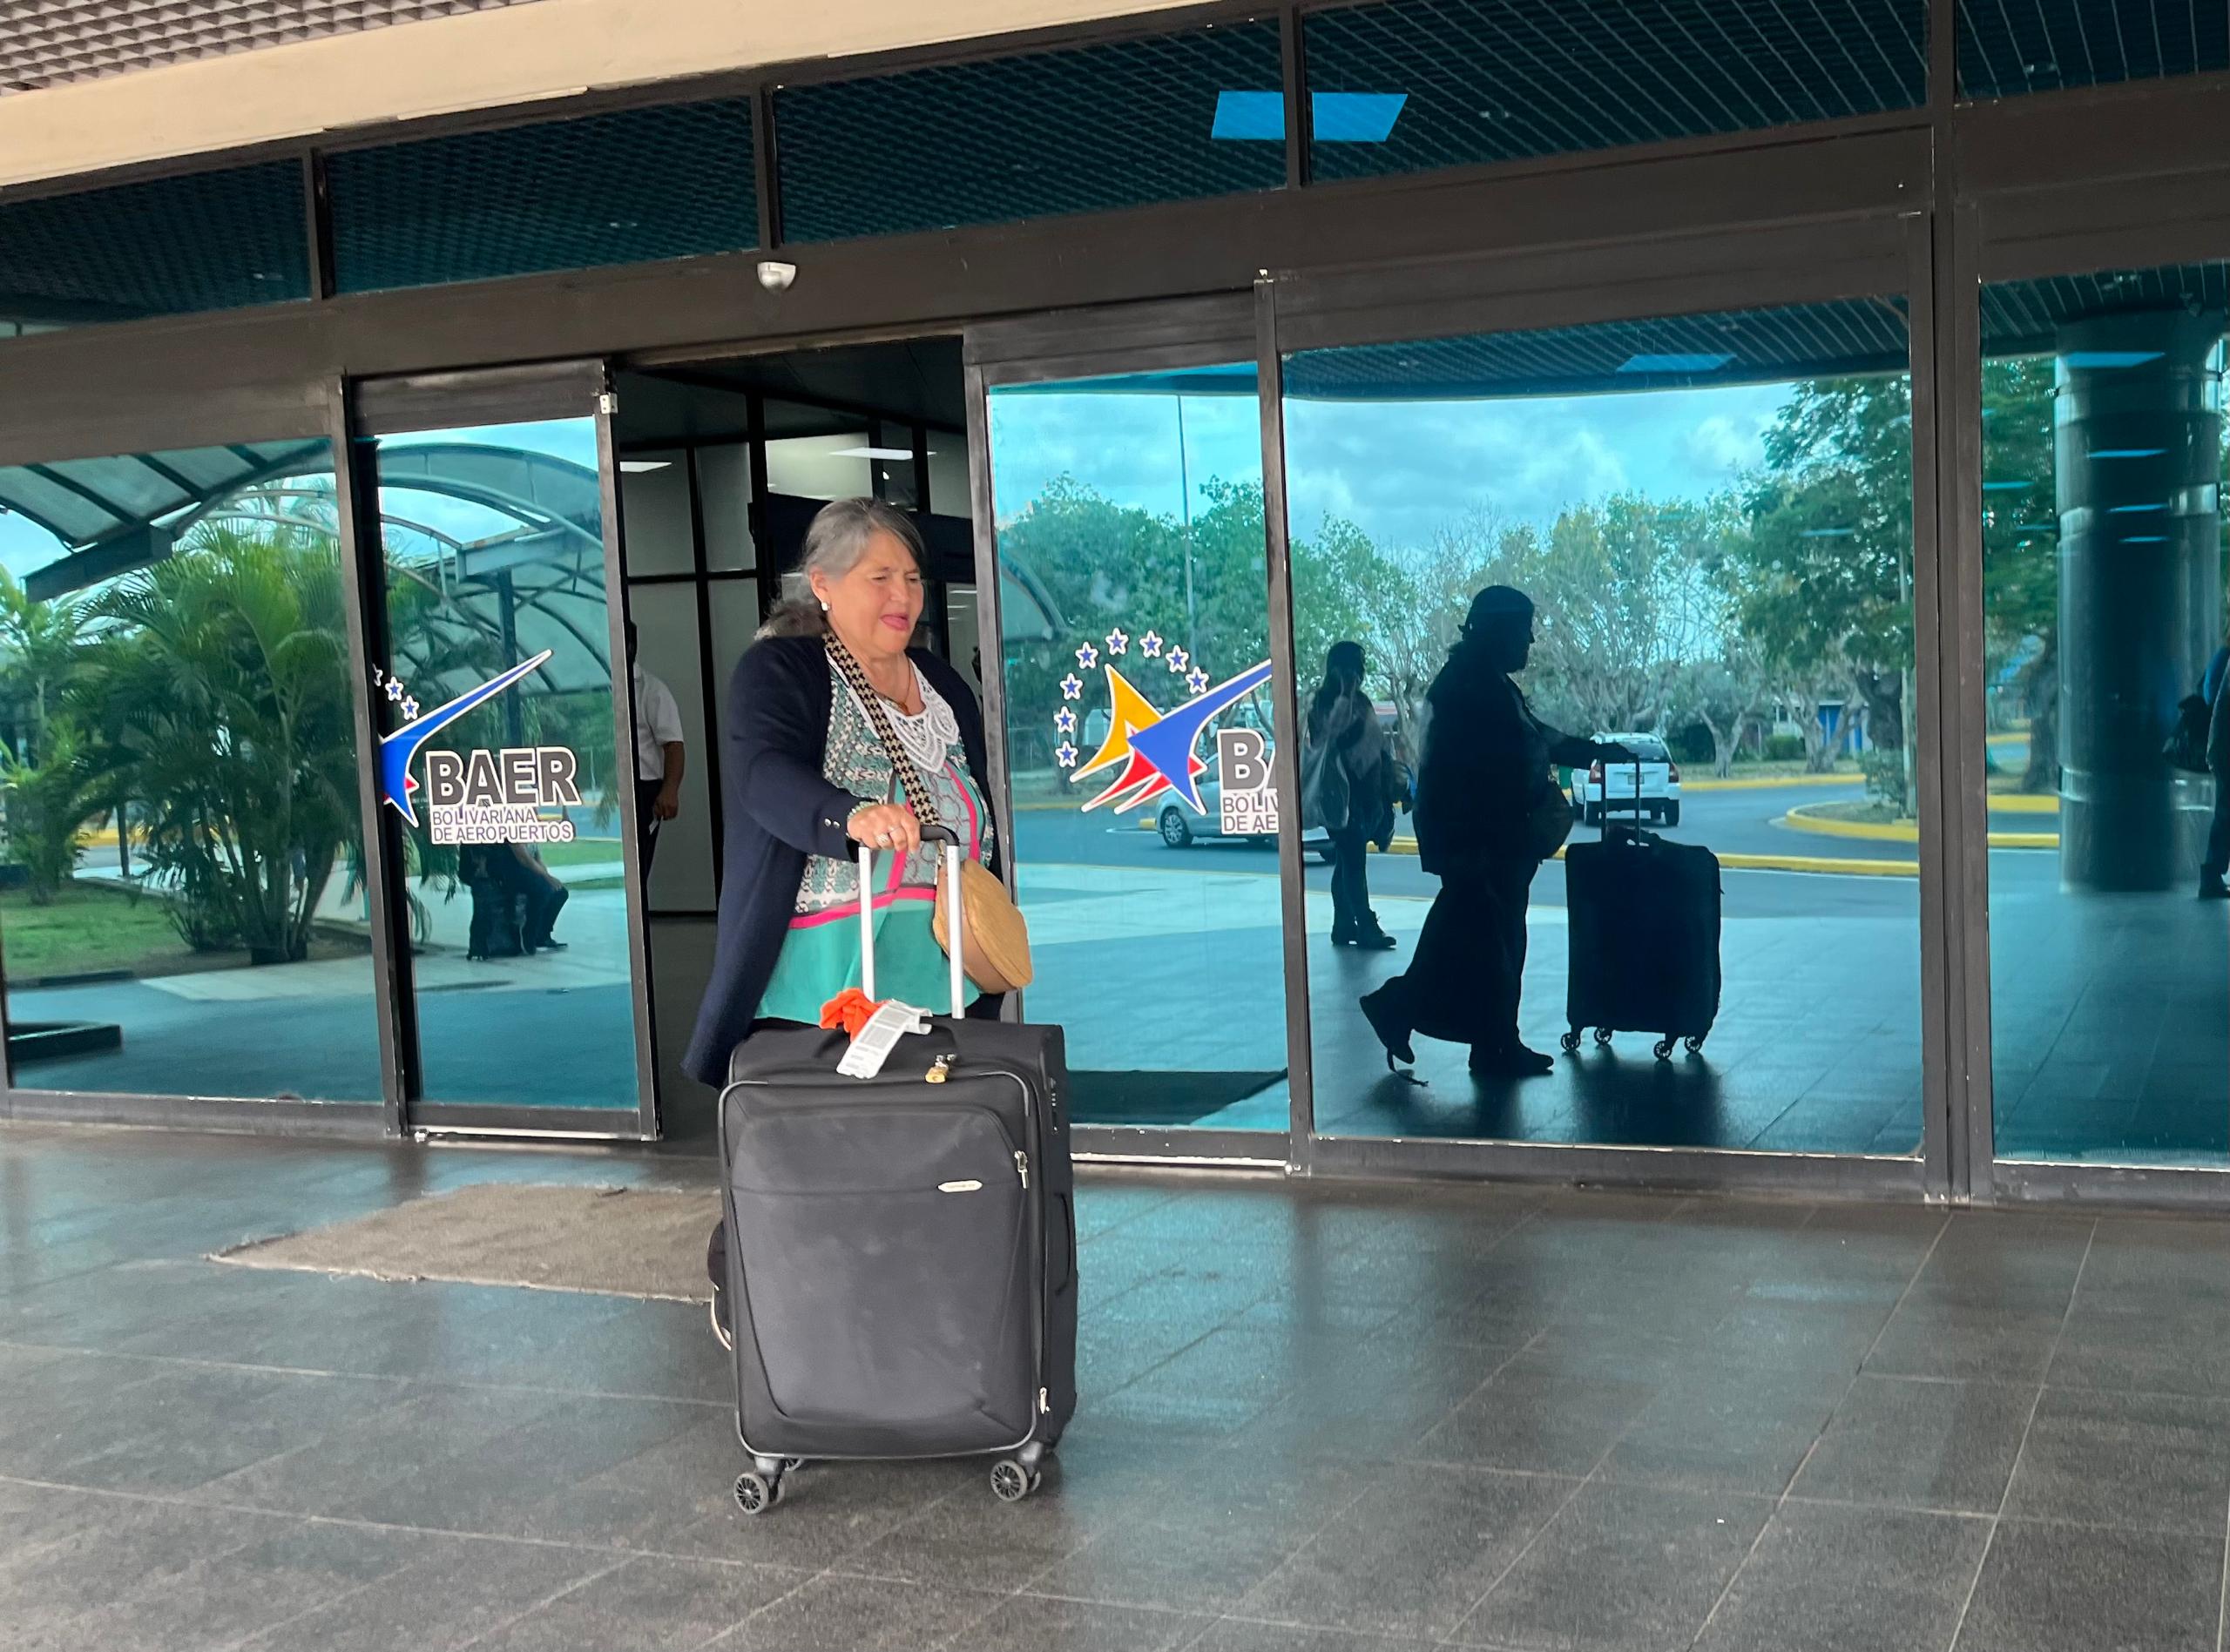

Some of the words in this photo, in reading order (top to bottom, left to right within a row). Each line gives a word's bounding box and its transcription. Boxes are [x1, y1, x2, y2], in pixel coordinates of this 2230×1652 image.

[427, 747, 581, 806] BAER
[432, 809, 536, 826] BOLIVARIANA
[1224, 815, 1247, 832] DE
[1253, 814, 1277, 831] AE
[434, 827, 453, 842] DE
[456, 824, 571, 842] AEROPUERTOS
